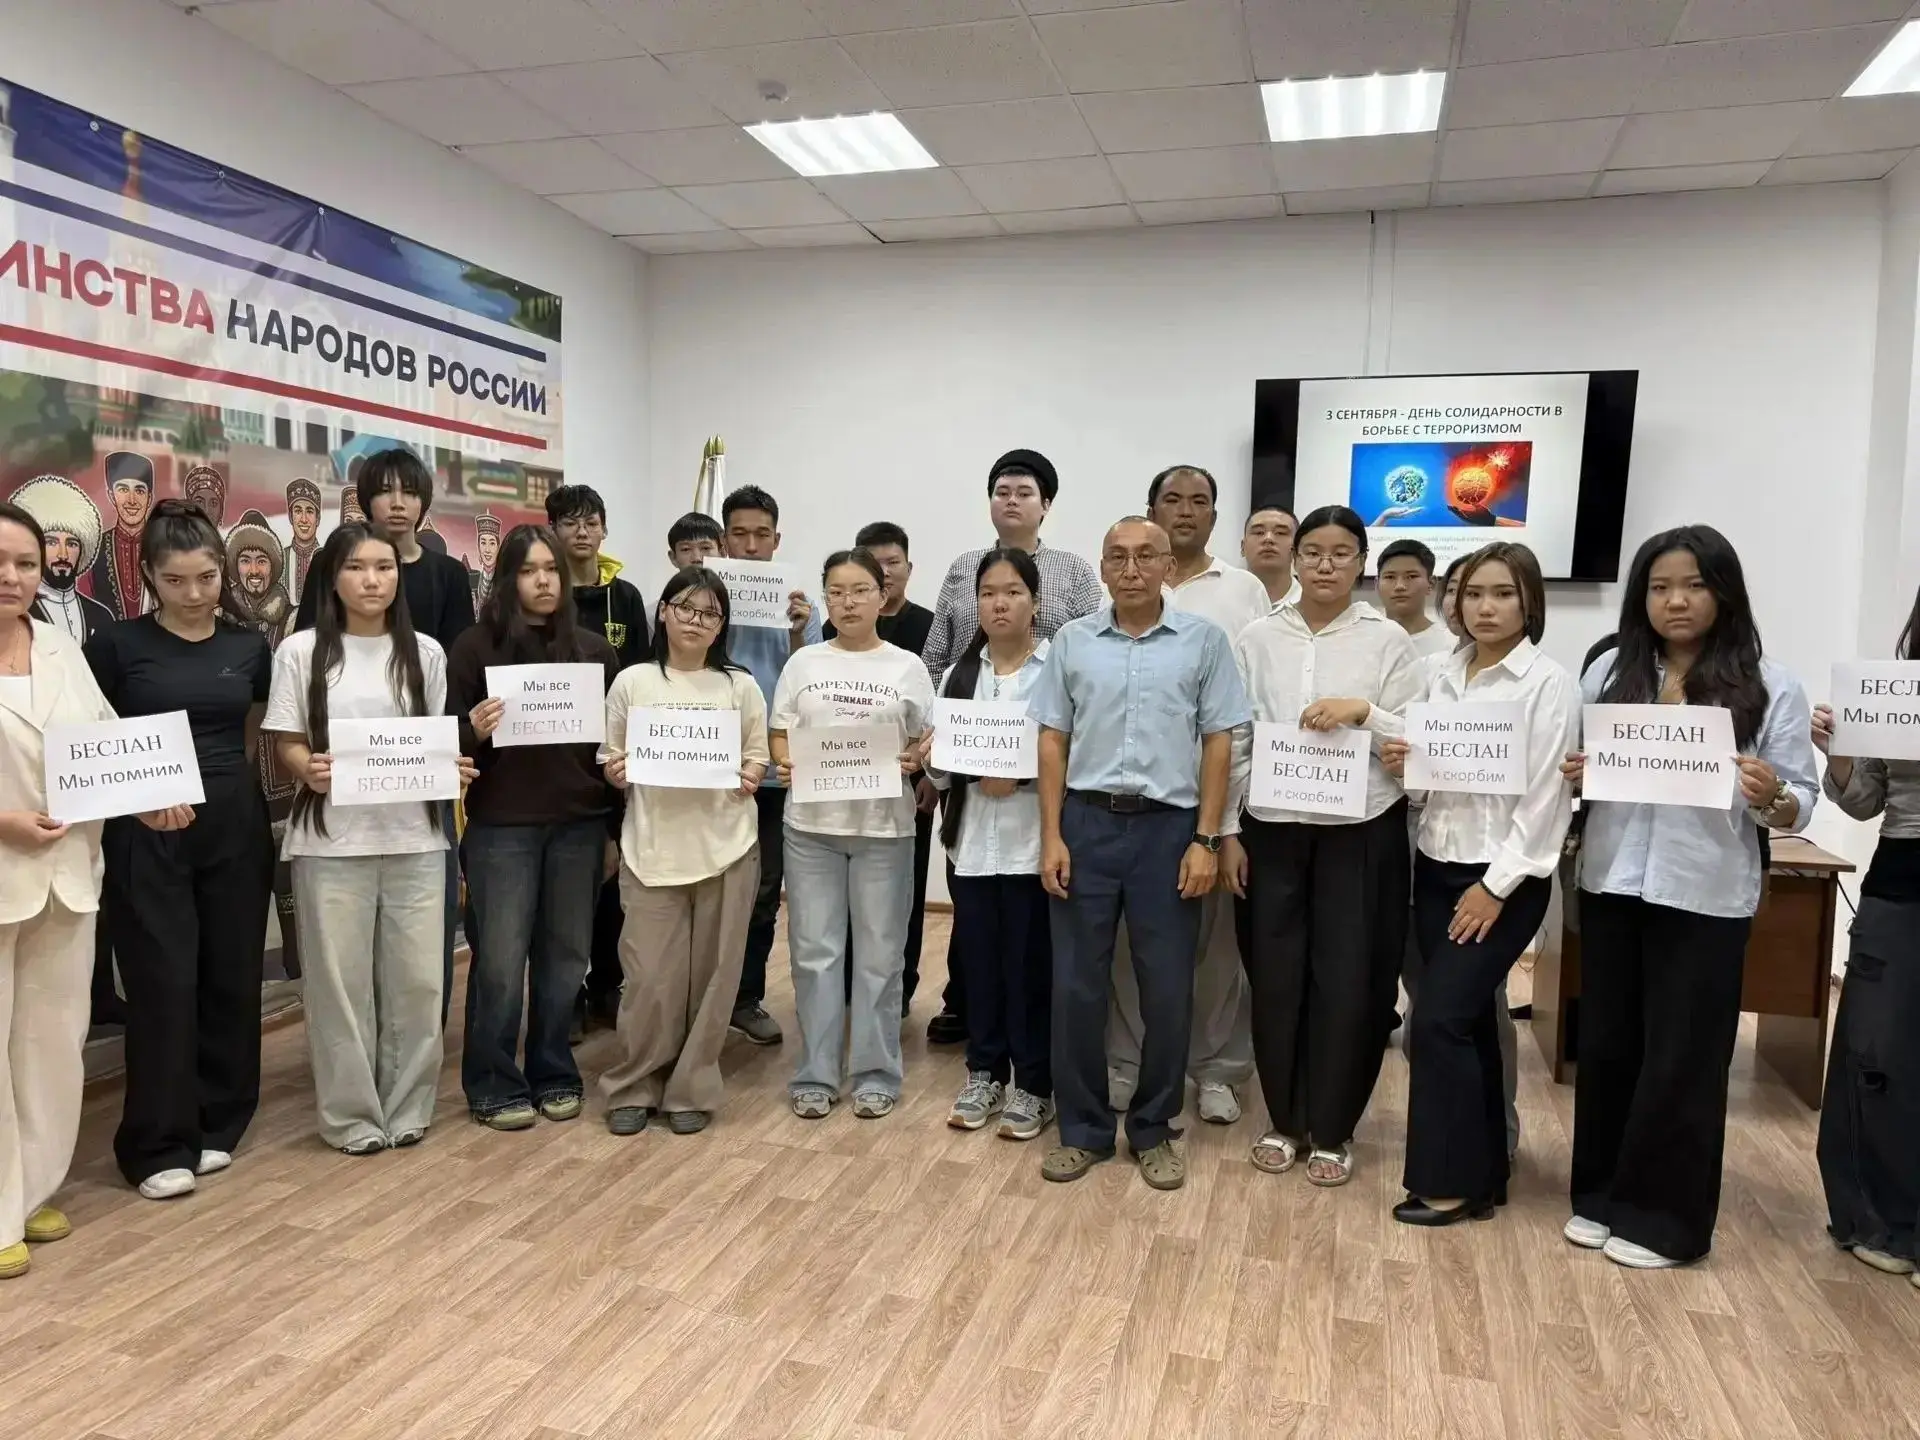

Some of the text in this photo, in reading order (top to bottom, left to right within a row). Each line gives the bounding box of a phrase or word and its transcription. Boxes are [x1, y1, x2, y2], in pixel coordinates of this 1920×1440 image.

[0, 240, 546, 415] ИНСТВА НАРОДОВ РОССИИ
[1326, 411, 1332, 420] 3
[1336, 408, 1397, 420] СЕНТЯБРЯ
[1408, 408, 1441, 420] ДЕНЬ
[1445, 406, 1551, 418] СОЛИДАРНОСТИ
[1554, 406, 1563, 416] В
[1362, 423, 1522, 436] БОРЬБЕ С ТЕРРОРИЗМОМ
[718, 571, 784, 584] Мы помним
[730, 588, 779, 603] ЕСЛАН
[731, 609, 776, 619] скорбим
[523, 681, 570, 692] Мы все
[521, 702, 573, 711] помним
[833, 694, 873, 705] DENMARK
[950, 714, 1025, 727] Мы помним
[1844, 708, 1879, 723] Мы
[512, 719, 583, 735] БЕСЛАН
[649, 724, 719, 739] БЕСЛАН
[1425, 720, 1512, 732] Мы помним
[1613, 723, 1705, 743] БЕСЛАН
[69, 735, 162, 760] БЕСЛАН
[369, 735, 422, 746] Мы все
[821, 740, 867, 750] Мы все
[953, 734, 1021, 749] БЕСЛАН
[636, 746, 729, 761] Мы помним
[1271, 740, 1355, 759] Мы помним
[1428, 742, 1508, 758] БЕСЛАН
[367, 756, 425, 767] помним
[821, 758, 871, 768] помним
[964, 758, 1017, 769] скорбим
[1598, 752, 1719, 773] Мы помним
[59, 763, 183, 790] Мы помним
[1273, 762, 1349, 783] БЕСЛАН
[1431, 769, 1505, 783] и скорбим
[358, 775, 434, 792] БЕСЛАН
[814, 775, 880, 791] БЕСЛАН
[1273, 788, 1344, 805] и скорбим
